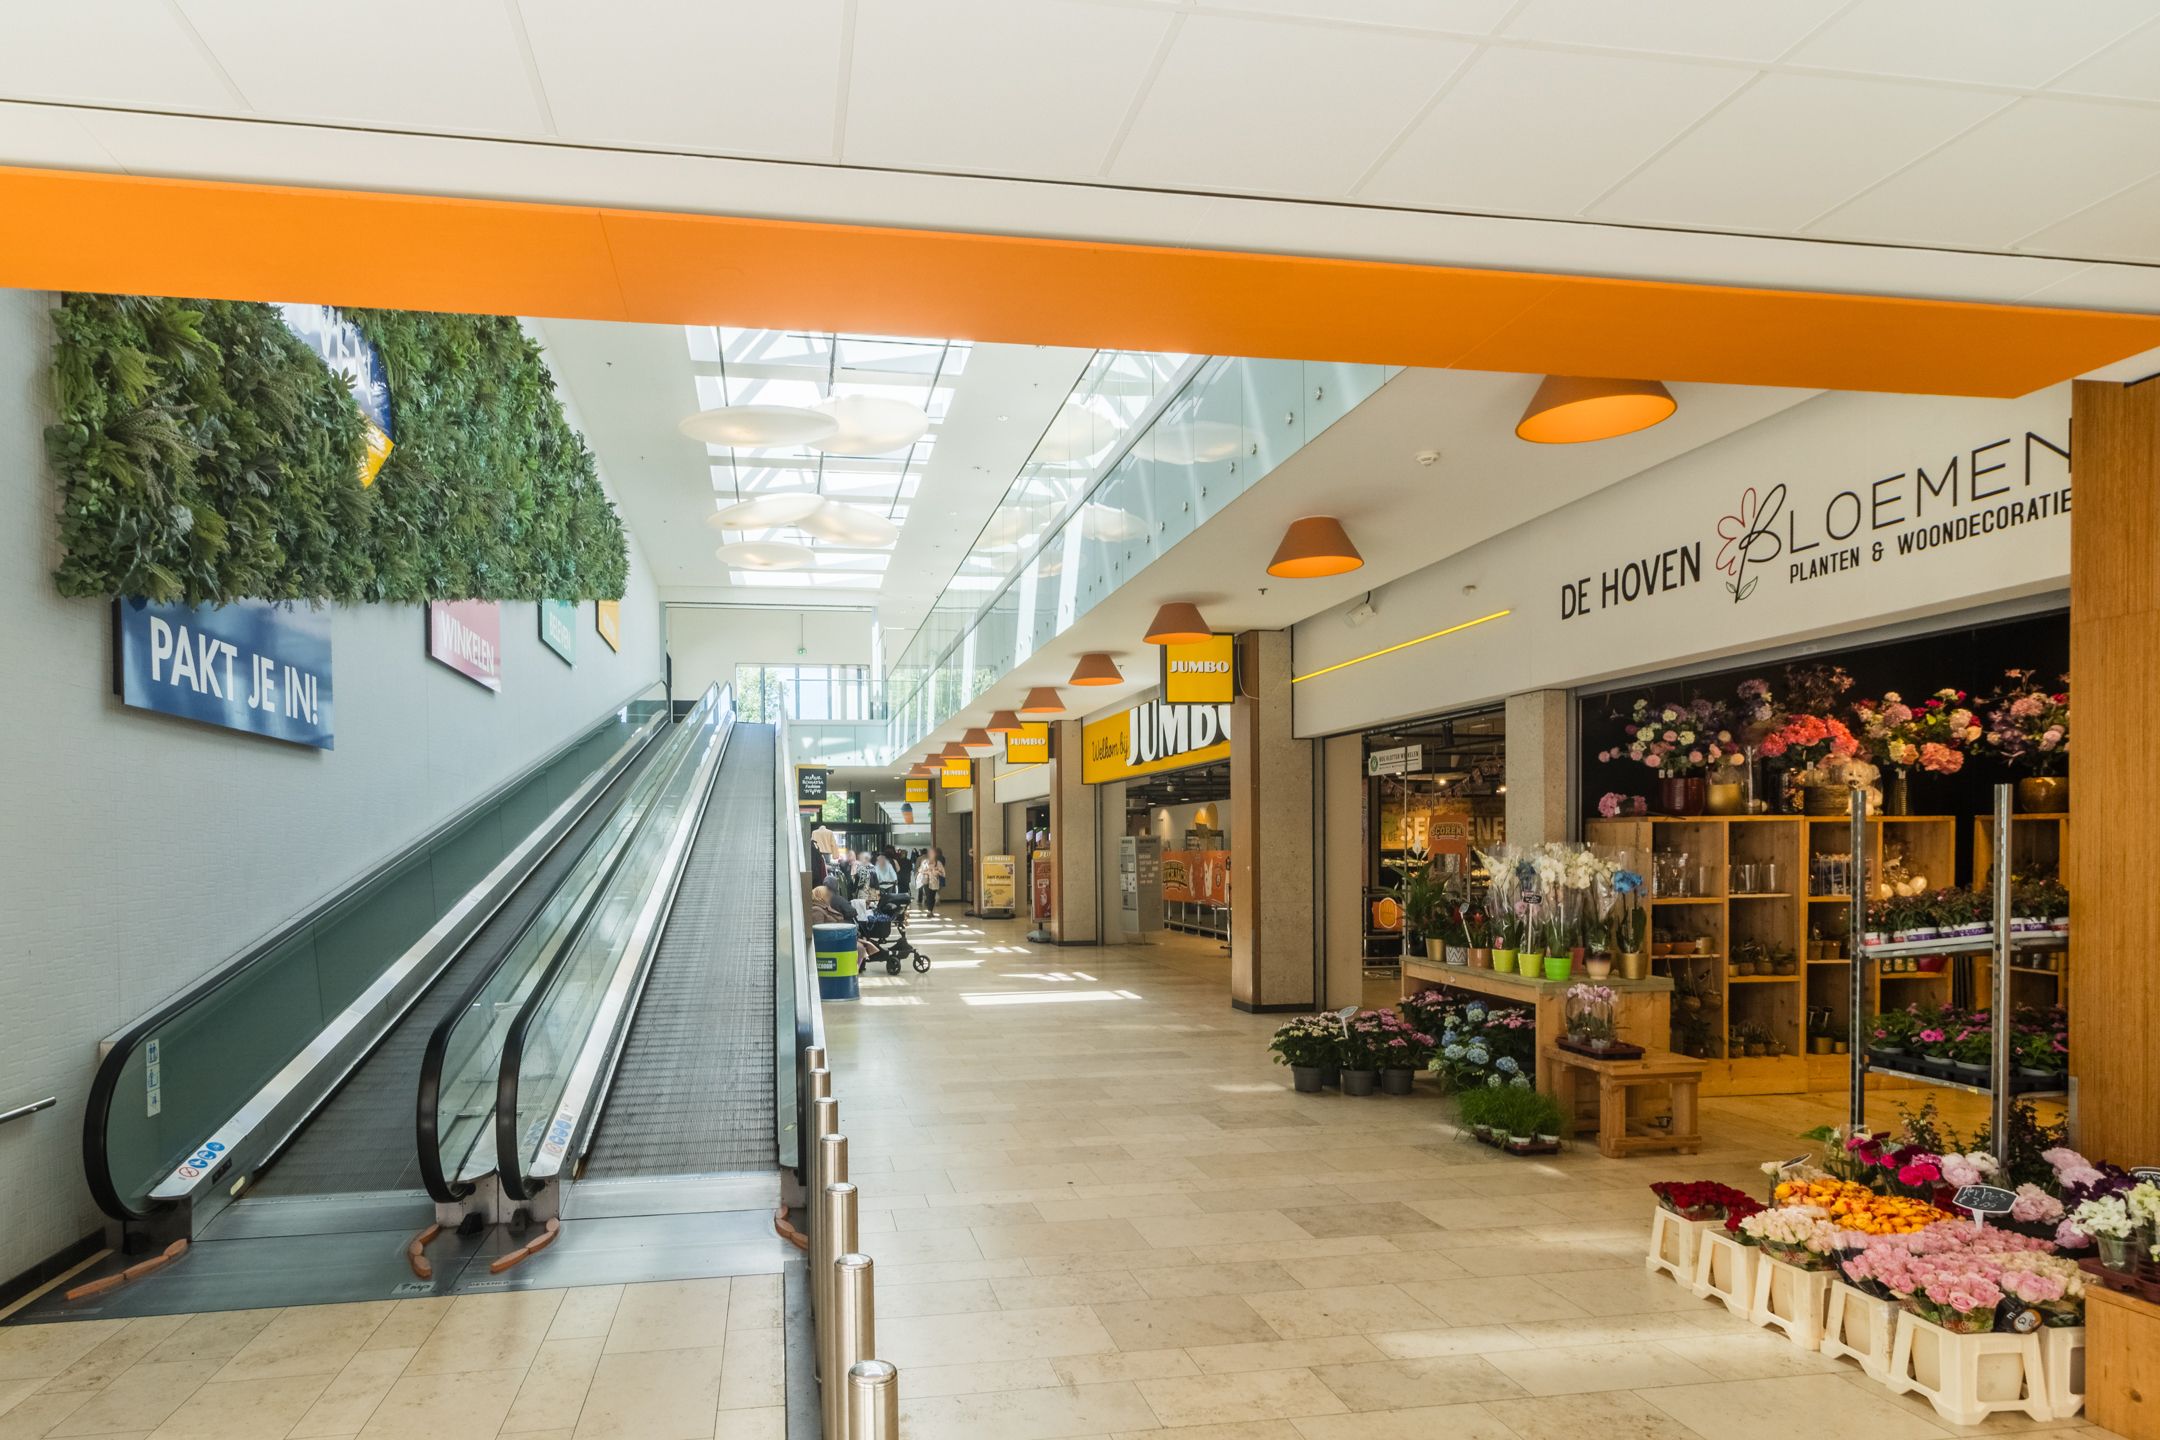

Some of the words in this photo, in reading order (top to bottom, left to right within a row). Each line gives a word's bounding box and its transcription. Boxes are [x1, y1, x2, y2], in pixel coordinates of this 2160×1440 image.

[1561, 576, 1591, 620] DE
[1602, 541, 1700, 609] HOVEN
[1735, 418, 2071, 603] BLOEMEN
[1790, 546, 1860, 584] PLANTEN
[1872, 541, 1884, 562] &
[1897, 487, 2071, 556] WOONDECORATIE
[440, 609, 495, 677] WINKELEN
[1170, 660, 1230, 673] JUMBO
[150, 615, 238, 702] PAKT
[248, 653, 276, 713] JE
[284, 665, 318, 726] IN!
[1009, 738, 1046, 746] JUMBO
[1092, 737, 1118, 762] Welkom
[1119, 731, 1129, 762] bij
[943, 769, 969, 777] JUMBO
